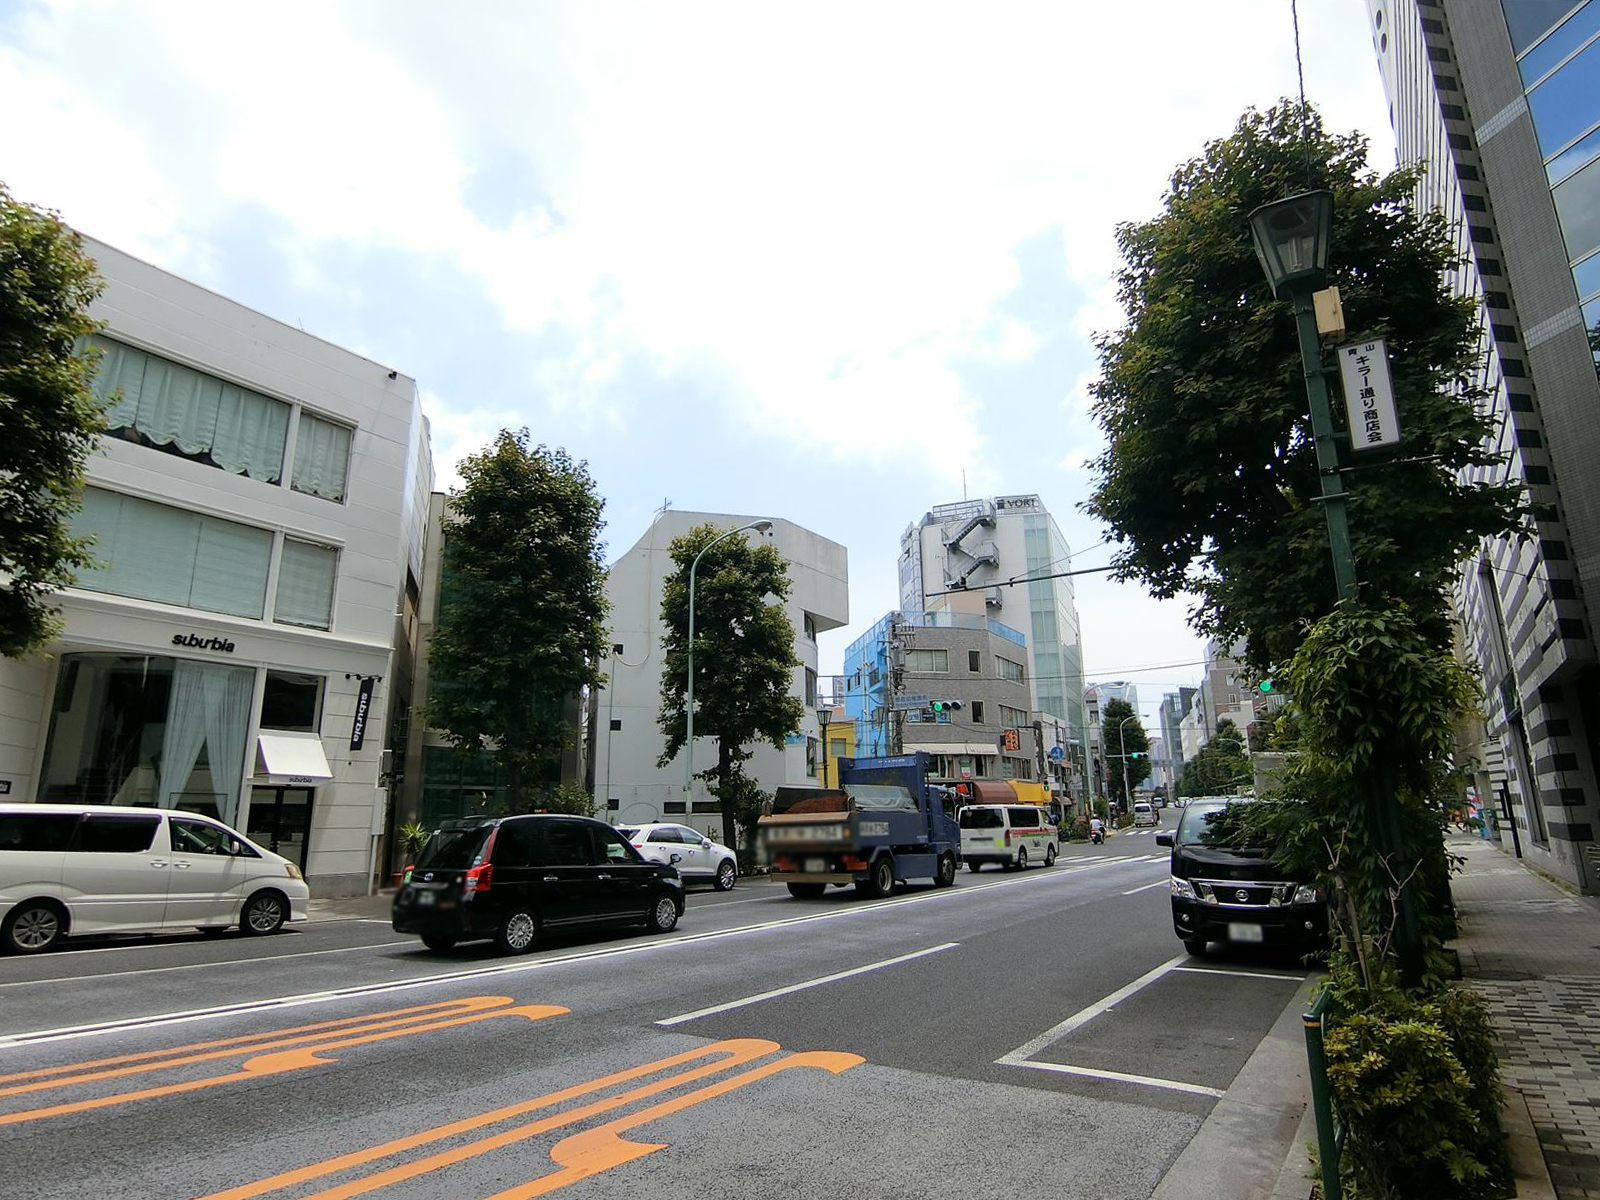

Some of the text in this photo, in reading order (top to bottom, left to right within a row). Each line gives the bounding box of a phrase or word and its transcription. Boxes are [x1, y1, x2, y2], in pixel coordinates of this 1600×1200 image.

[1347, 344, 1375, 357] 青山
[1355, 355, 1383, 443] キラー通り商店会
[171, 633, 236, 653] suburbia
[353, 692, 368, 742] suburbia
